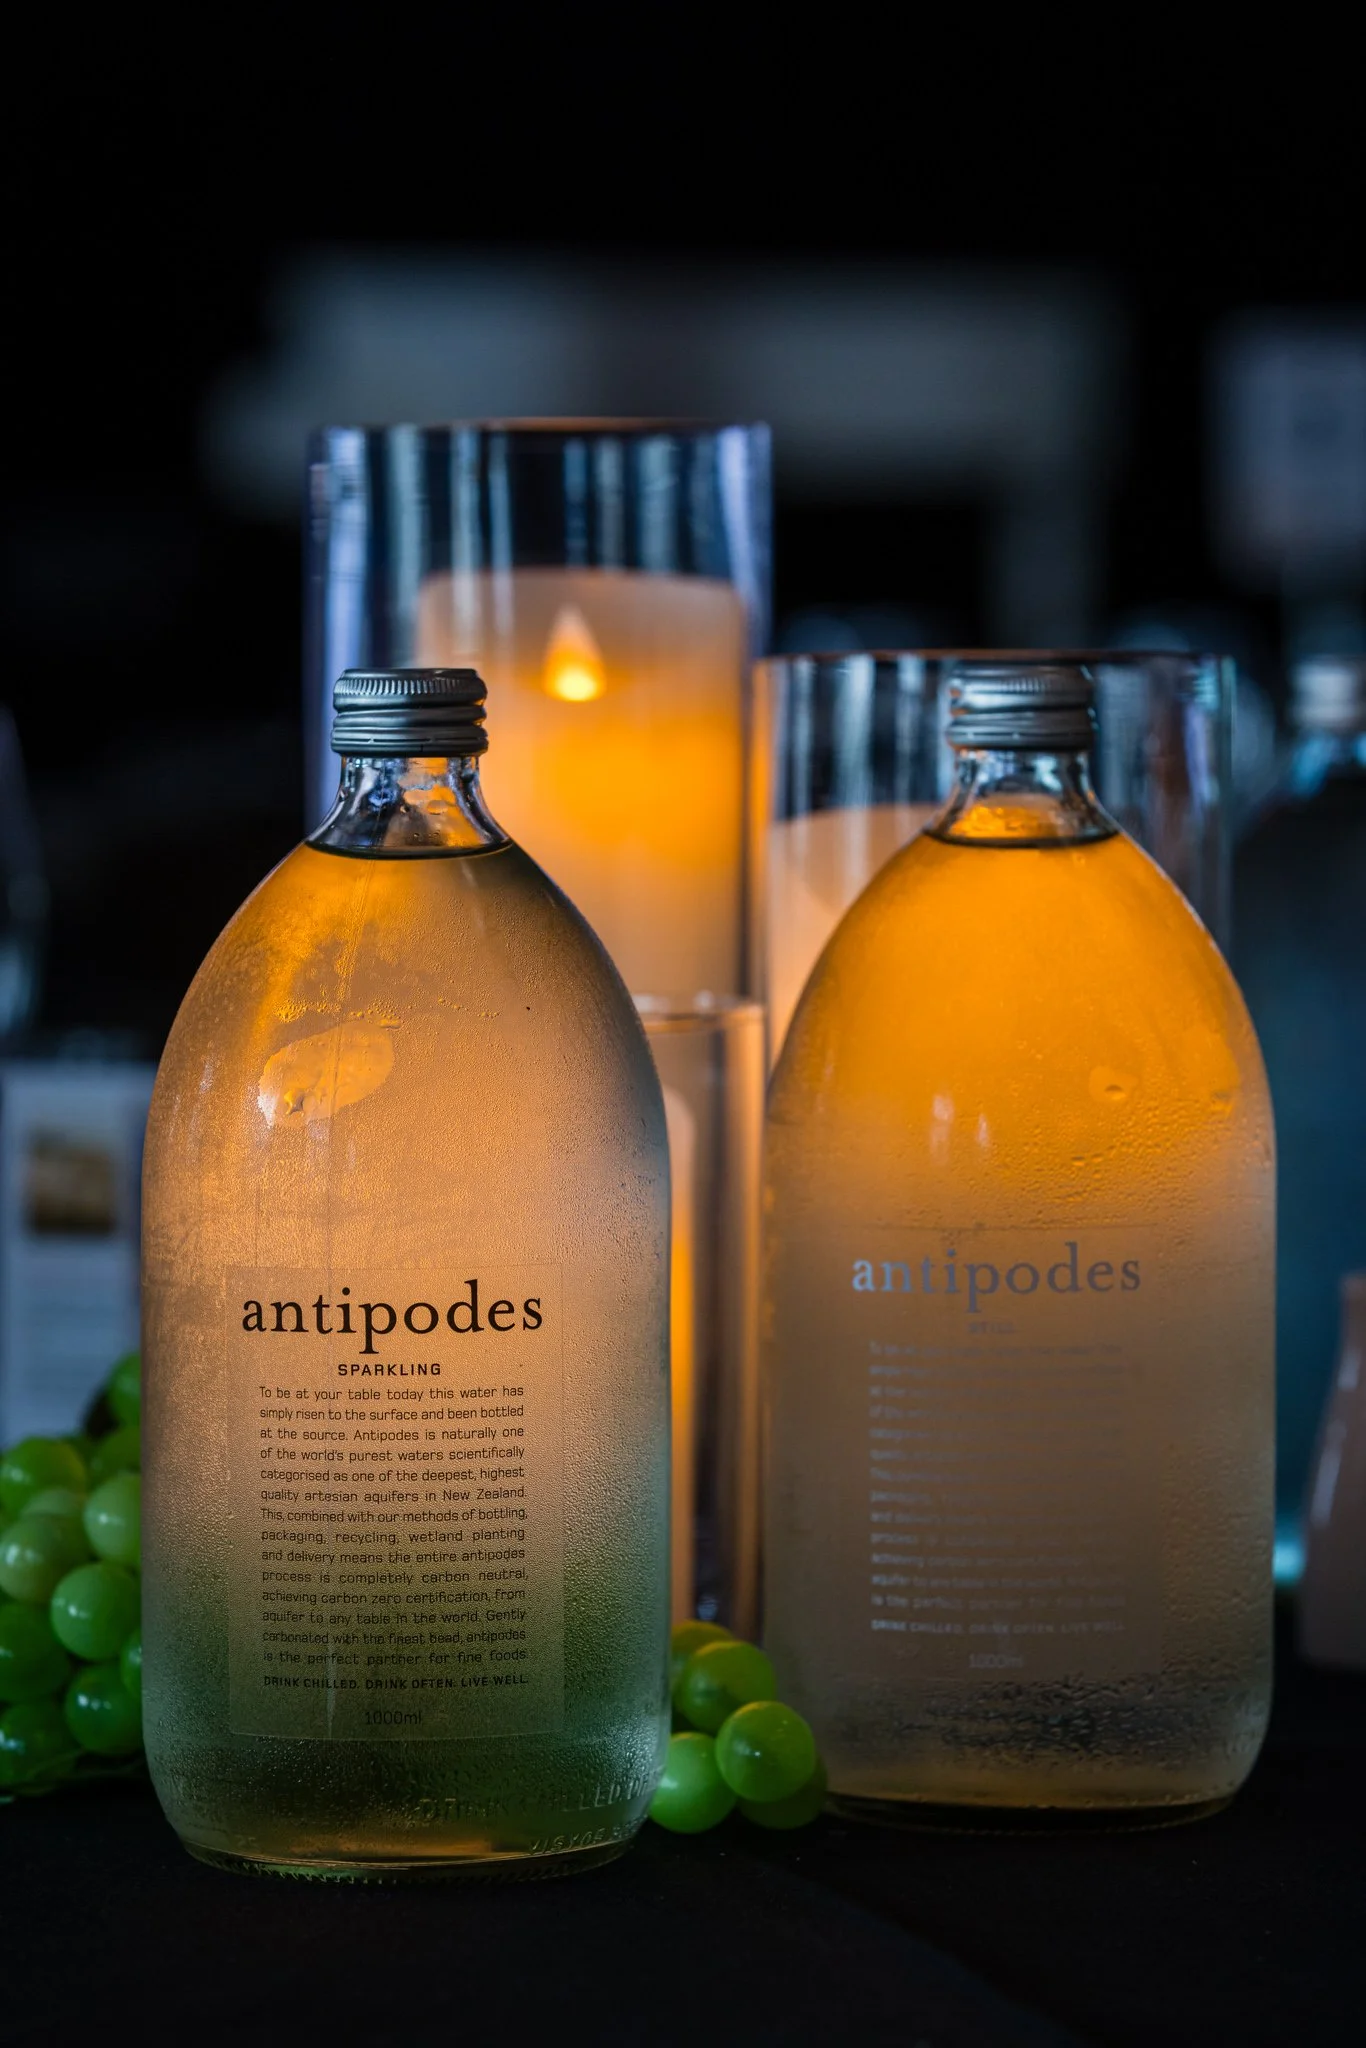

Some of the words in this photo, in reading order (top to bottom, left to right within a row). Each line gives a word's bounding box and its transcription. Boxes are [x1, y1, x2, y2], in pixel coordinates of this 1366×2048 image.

[852, 1241, 1141, 1313] antipodes
[242, 1279, 543, 1354] antipodes
[338, 1364, 441, 1376] SPARKLING
[260, 1387, 271, 1398] To
[277, 1388, 291, 1398] be
[296, 1389, 309, 1399] at
[315, 1390, 342, 1401] your
[348, 1389, 380, 1400] table
[387, 1389, 423, 1401] today
[429, 1388, 454, 1399] this
[460, 1388, 497, 1398] water
[502, 1385, 524, 1397] has
[260, 1408, 292, 1421] simply
[296, 1409, 324, 1420] risen
[328, 1410, 341, 1420] to
[345, 1409, 366, 1420] the
[370, 1409, 418, 1420] surface
[421, 1408, 443, 1420] and
[448, 1407, 477, 1419] been
[481, 1405, 524, 1418] bottled
[260, 1428, 272, 1438] at
[278, 1429, 297, 1439] the
[303, 1430, 348, 1441] source.
[354, 1430, 419, 1442] Antipodes
[425, 1429, 435, 1440] is
[442, 1427, 496, 1441] naturally
[502, 1427, 524, 1437] one
[261, 1448, 272, 1459] of
[277, 1449, 296, 1460] the
[350, 1450, 392, 1463] purest
[398, 1450, 443, 1461] waters
[449, 1447, 525, 1460] scientifically
[261, 1469, 330, 1482] categorised
[334, 1472, 348, 1481] as
[352, 1472, 374, 1482] one
[379, 1470, 393, 1481] of
[397, 1470, 418, 1481] the
[422, 1469, 476, 1483] deepest,
[480, 1467, 525, 1480] highest
[261, 1489, 299, 1502] quality
[305, 1490, 357, 1501] artesian
[364, 1491, 419, 1504] aquifers
[426, 1490, 436, 1501] in
[443, 1489, 470, 1500] New
[477, 1487, 527, 1499] Zealand.
[287, 1511, 344, 1523] combined
[348, 1512, 375, 1523] with
[377, 1513, 399, 1523] our
[403, 1510, 458, 1522] methods
[462, 1509, 475, 1520] of
[478, 1507, 528, 1520] bottling,
[261, 1529, 327, 1545] packaging,
[409, 1530, 463, 1542] wetland
[472, 1528, 525, 1540] planting
[261, 1550, 283, 1561] and
[287, 1550, 335, 1565] delivery
[340, 1553, 383, 1563] means
[388, 1551, 410, 1563] the
[416, 1551, 457, 1562] entire
[462, 1549, 525, 1562] antipodes
[262, 1571, 312, 1583] process
[319, 1571, 330, 1583] is
[339, 1572, 413, 1586] completely
[422, 1571, 470, 1583] carbon
[262, 1591, 317, 1605] achieving
[321, 1592, 367, 1604] carbon
[372, 1594, 402, 1604] zero
[495, 1589, 525, 1601] from
[310, 1613, 323, 1624] to
[329, 1615, 351, 1625] any
[357, 1613, 390, 1625] table
[397, 1613, 407, 1624] in
[413, 1613, 436, 1624] the
[264, 1676, 300, 1687] DRINK
[366, 1680, 407, 1689] DRINK
[461, 1677, 488, 1687] LIVE
[365, 1711, 422, 1725] 1000ml
